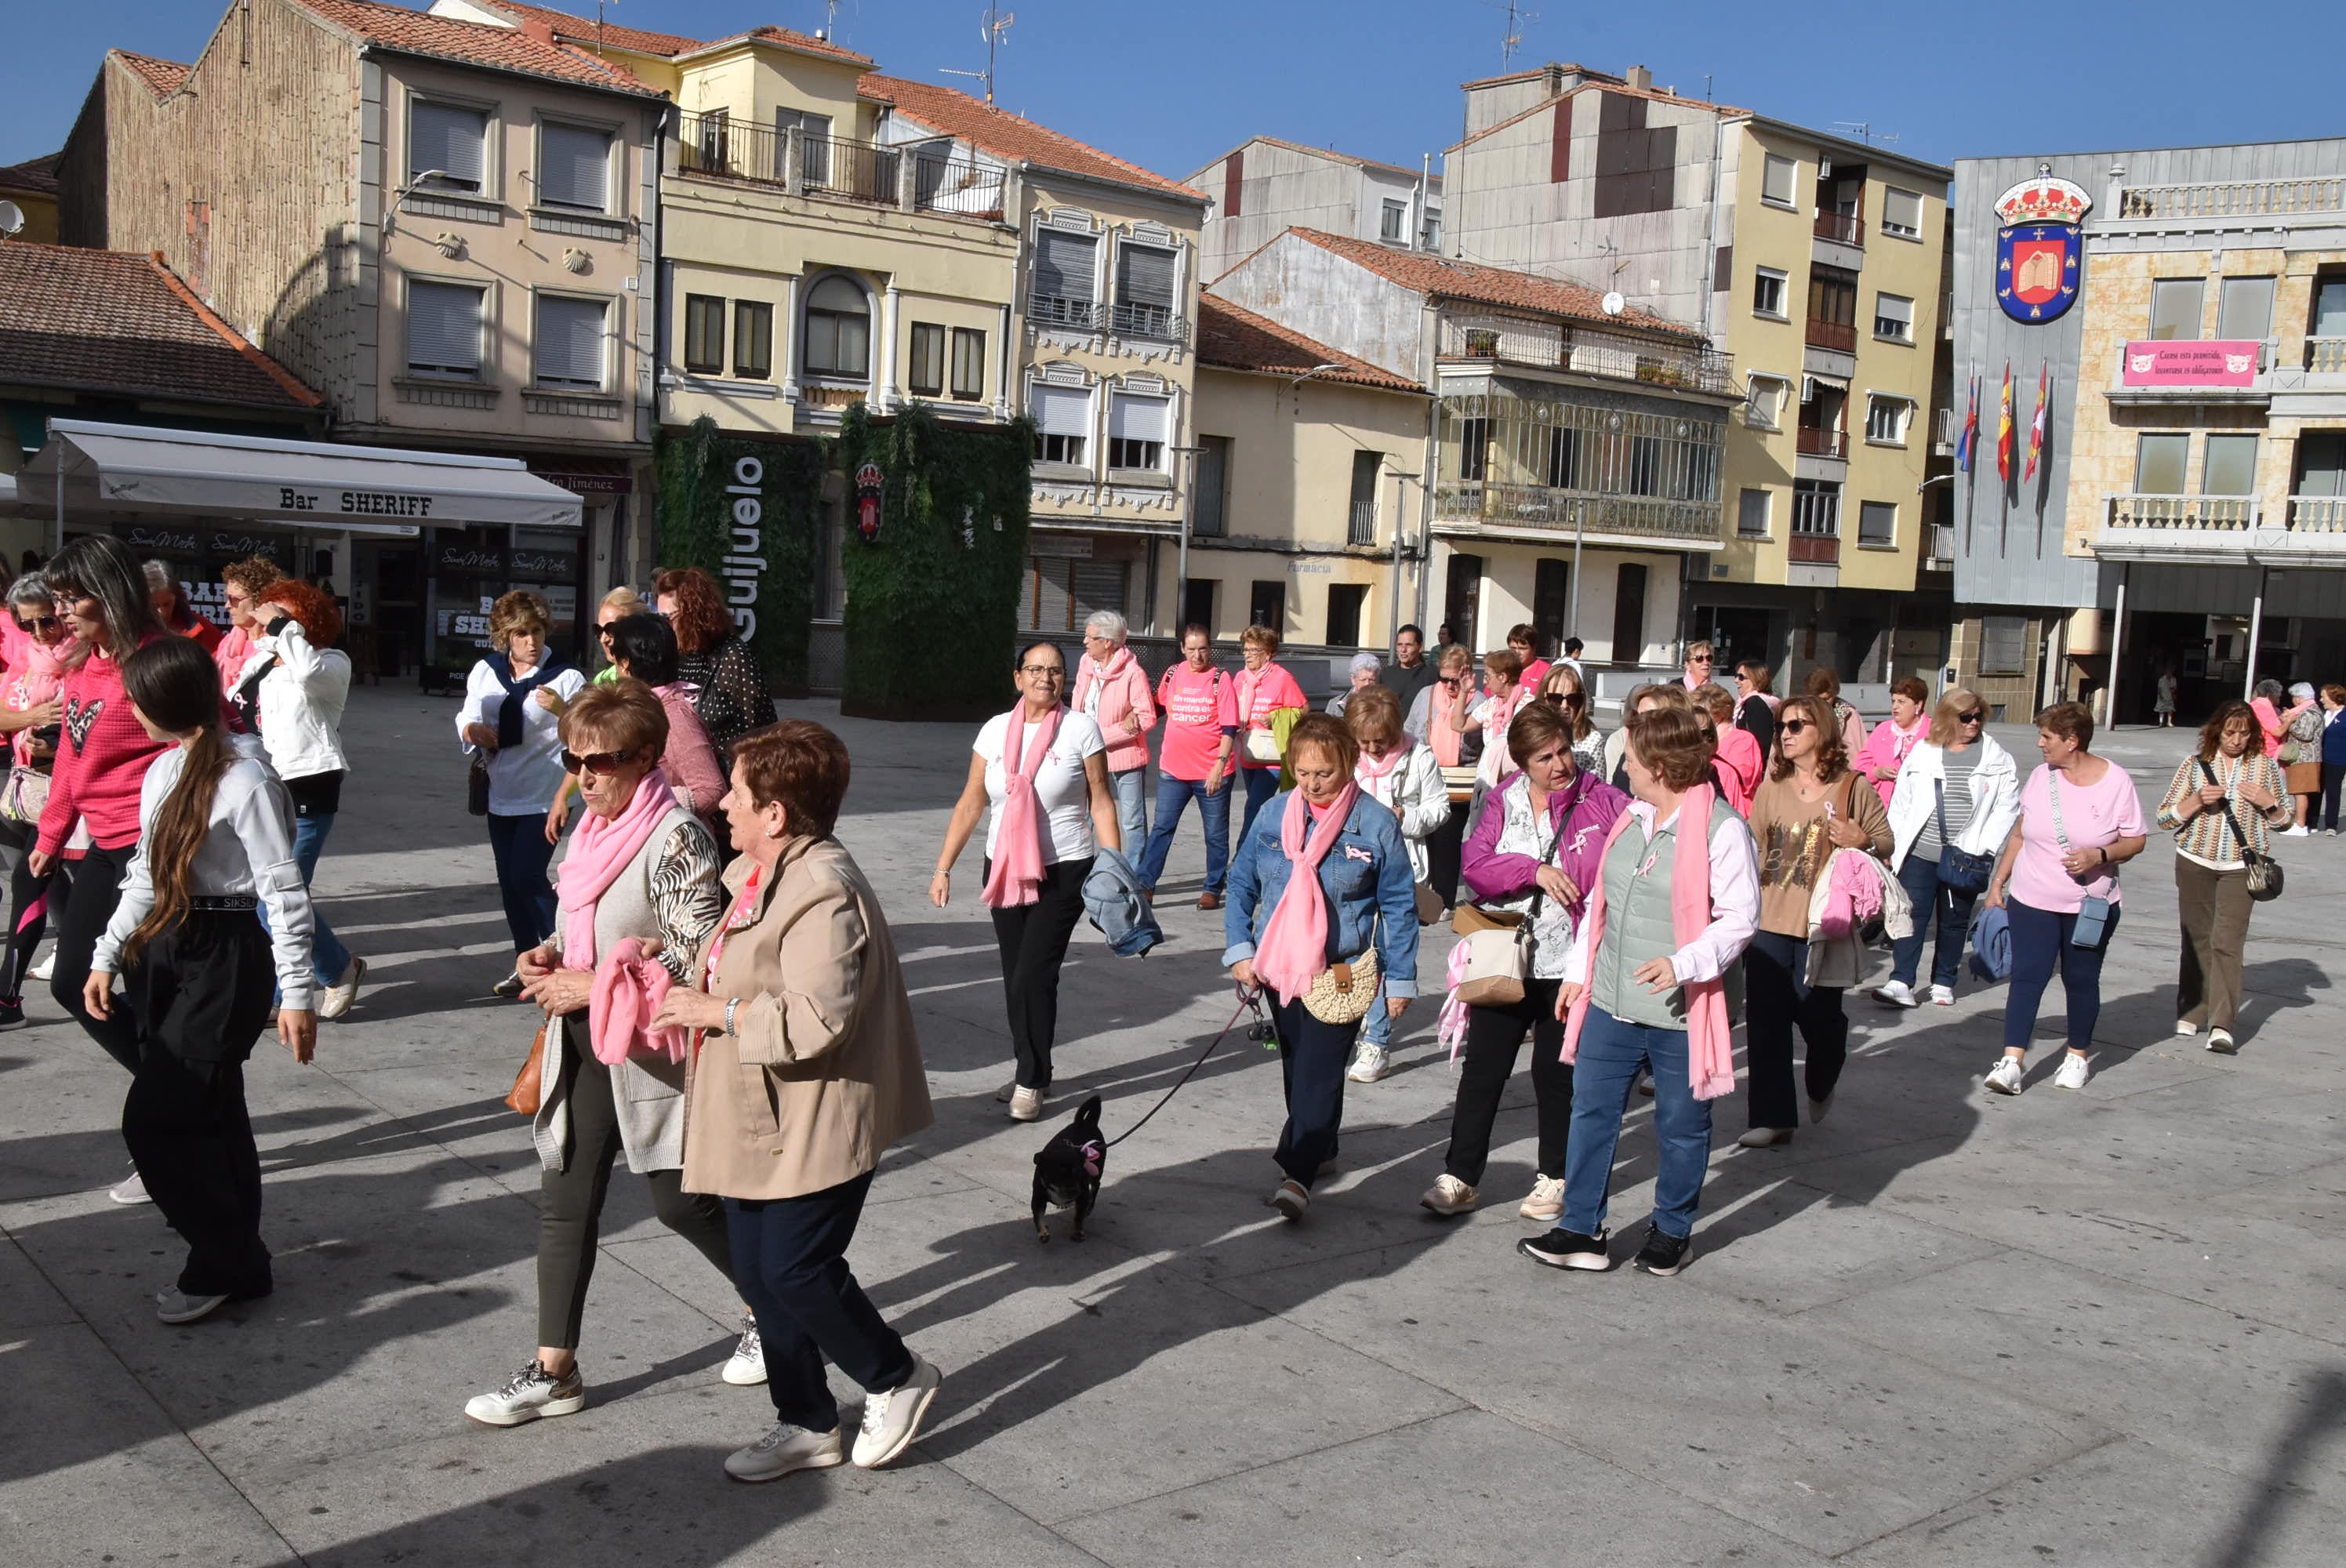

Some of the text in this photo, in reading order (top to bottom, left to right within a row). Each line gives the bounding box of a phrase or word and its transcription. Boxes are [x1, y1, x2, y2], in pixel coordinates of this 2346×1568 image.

[568, 477, 615, 490] Jiménez
[281, 488, 432, 516] Bar SHERIFF
[721, 456, 768, 643] Guijuelo
[455, 615, 491, 635] SH
[1173, 695, 1213, 704] En marcha
[1171, 704, 1211, 713] contra el
